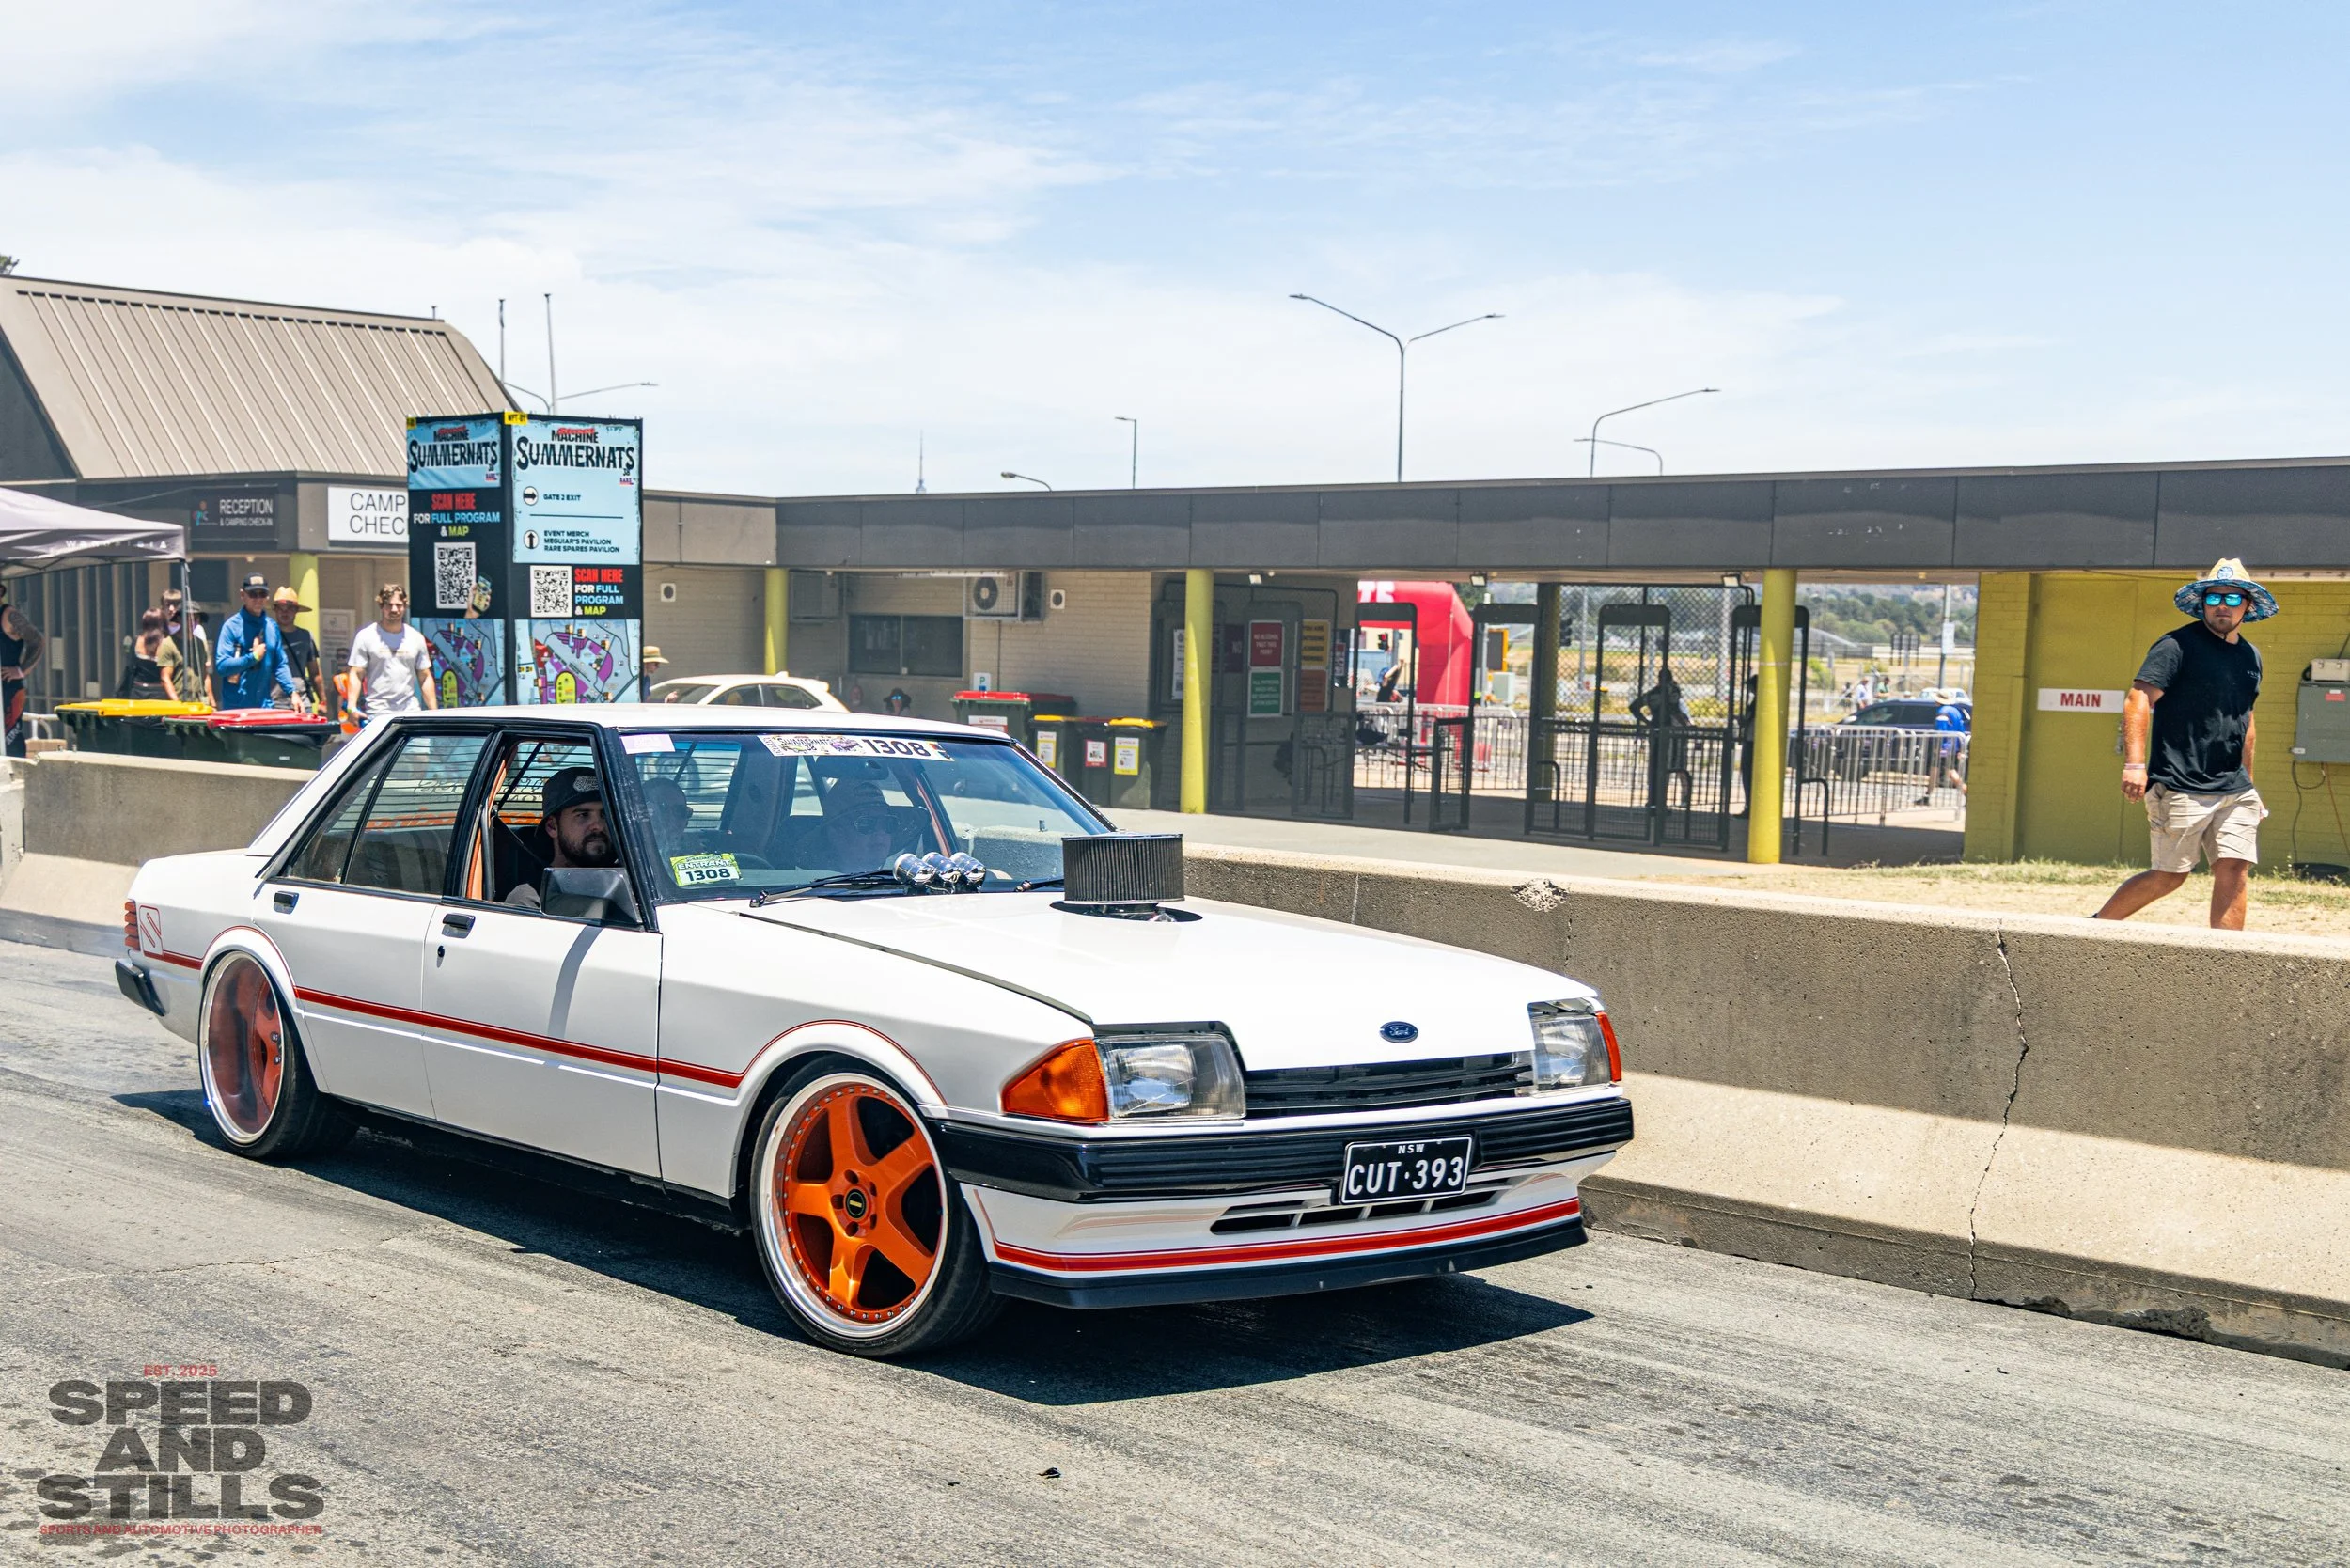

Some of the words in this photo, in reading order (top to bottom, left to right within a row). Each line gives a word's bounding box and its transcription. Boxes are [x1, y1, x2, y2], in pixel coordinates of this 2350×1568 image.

[551, 430, 599, 444] MACHINE
[409, 440, 498, 473] SUMMERNATS
[516, 436, 635, 471] SUMMERNATS
[219, 499, 274, 514] RECEPTION
[350, 493, 406, 512] CAMP
[431, 494, 453, 510] SCAN
[455, 492, 477, 510] HERE
[413, 513, 431, 524] FOR
[431, 513, 453, 524] FULL
[454, 512, 500, 523] PROGRAM
[440, 526, 447, 537] &
[448, 525, 469, 537] MAP
[574, 568, 599, 583] SCAN
[601, 569, 623, 583] HERE
[574, 584, 595, 594] FOR
[596, 585, 619, 594] FULL
[575, 595, 624, 604] PROGRAM
[574, 606, 583, 615] &
[584, 606, 606, 615] MAP
[2060, 693, 2101, 707] MAIN
[862, 739, 932, 757] 1308
[677, 859, 730, 870] ENTRANT
[686, 868, 731, 882] 1308
[1398, 1143, 1425, 1154] NSW
[1348, 1162, 1402, 1195] CUT
[1412, 1156, 1463, 1190] 393
